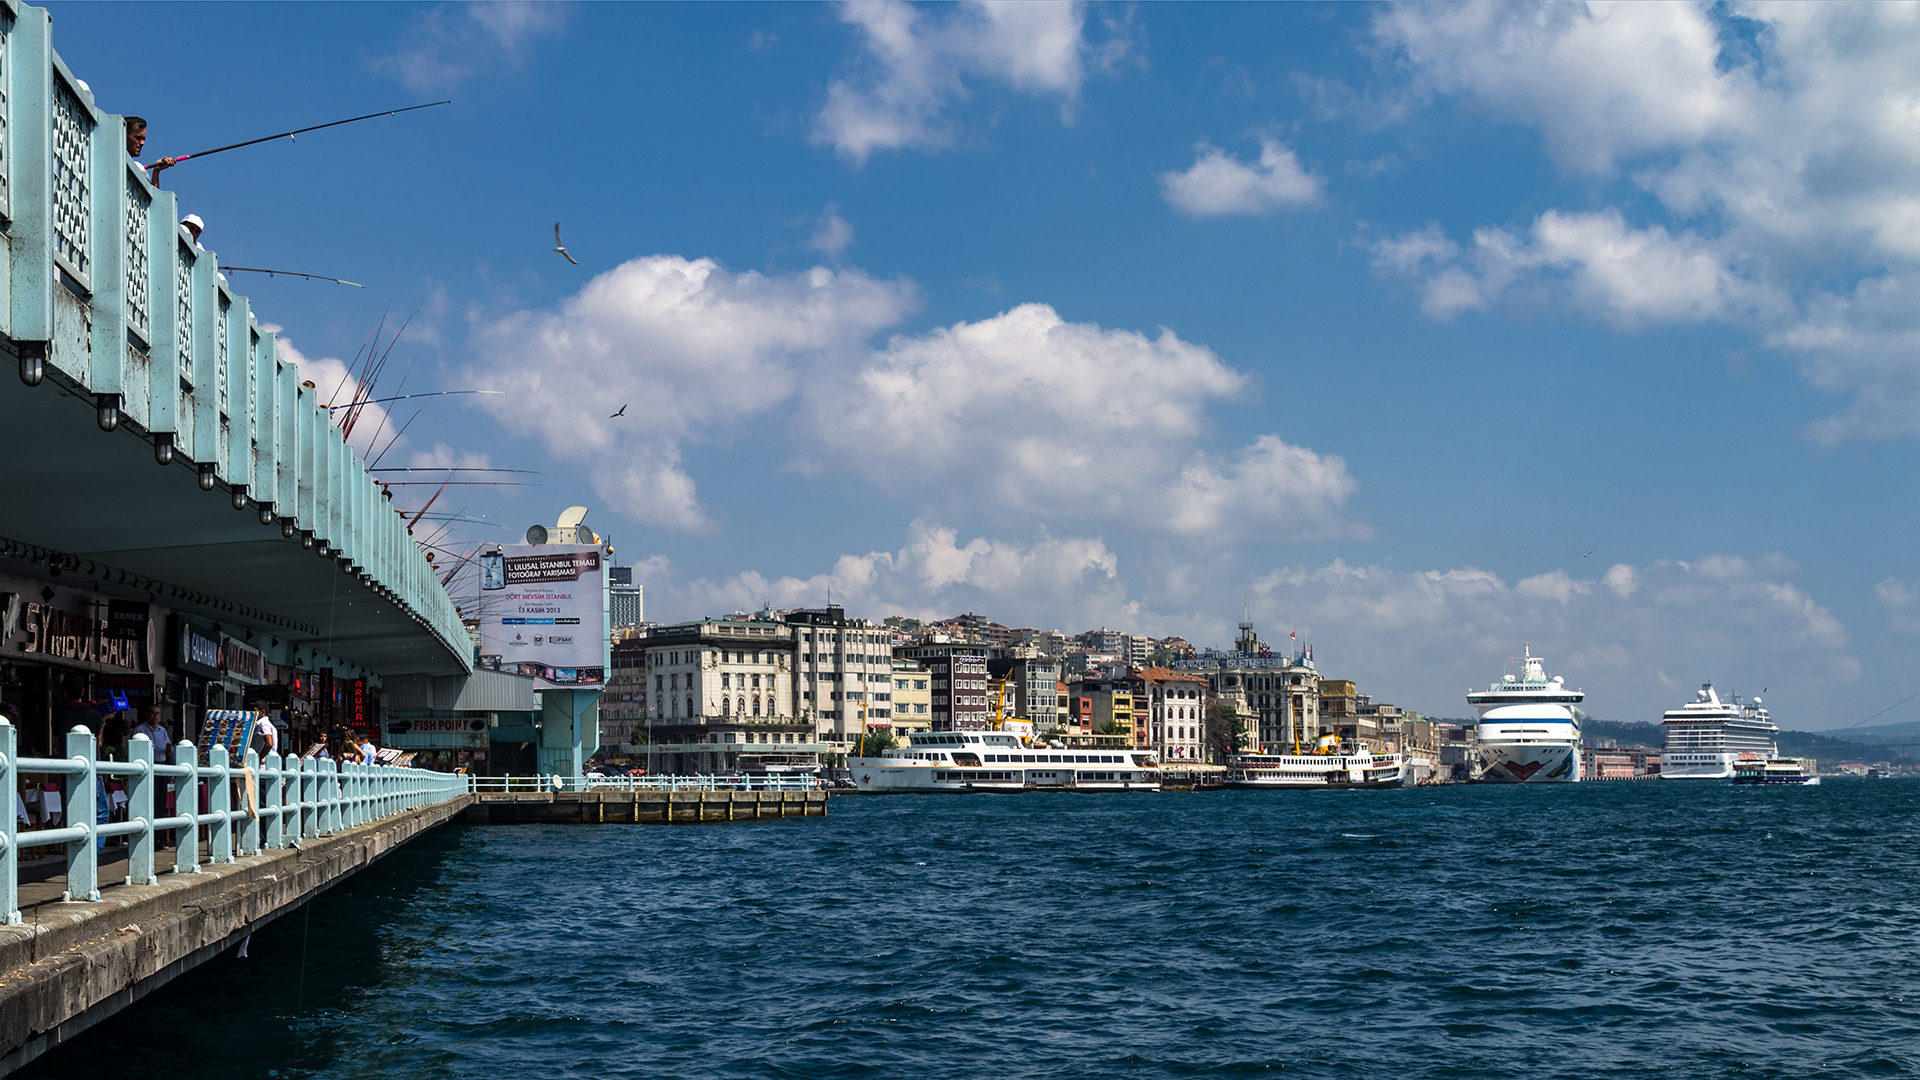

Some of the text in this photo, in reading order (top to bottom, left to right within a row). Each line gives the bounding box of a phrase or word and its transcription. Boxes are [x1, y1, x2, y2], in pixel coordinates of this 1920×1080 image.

[514, 563, 538, 571] ULUSAL
[540, 560, 572, 570] İSTANBUL
[572, 559, 596, 567] TEMALI
[508, 568, 576, 578] FOTOĞRAF YARIŞMASI
[114, 612, 144, 621] EKMEK
[25, 602, 96, 662] SYMBOL
[127, 628, 136, 636] TL
[1212, 650, 1244, 658] TÜRKİYE
[101, 676, 150, 688] SYMBOL
[128, 689, 151, 697] MEAT
[354, 680, 363, 720] ARUNA
[414, 720, 468, 730] FISH POINT
